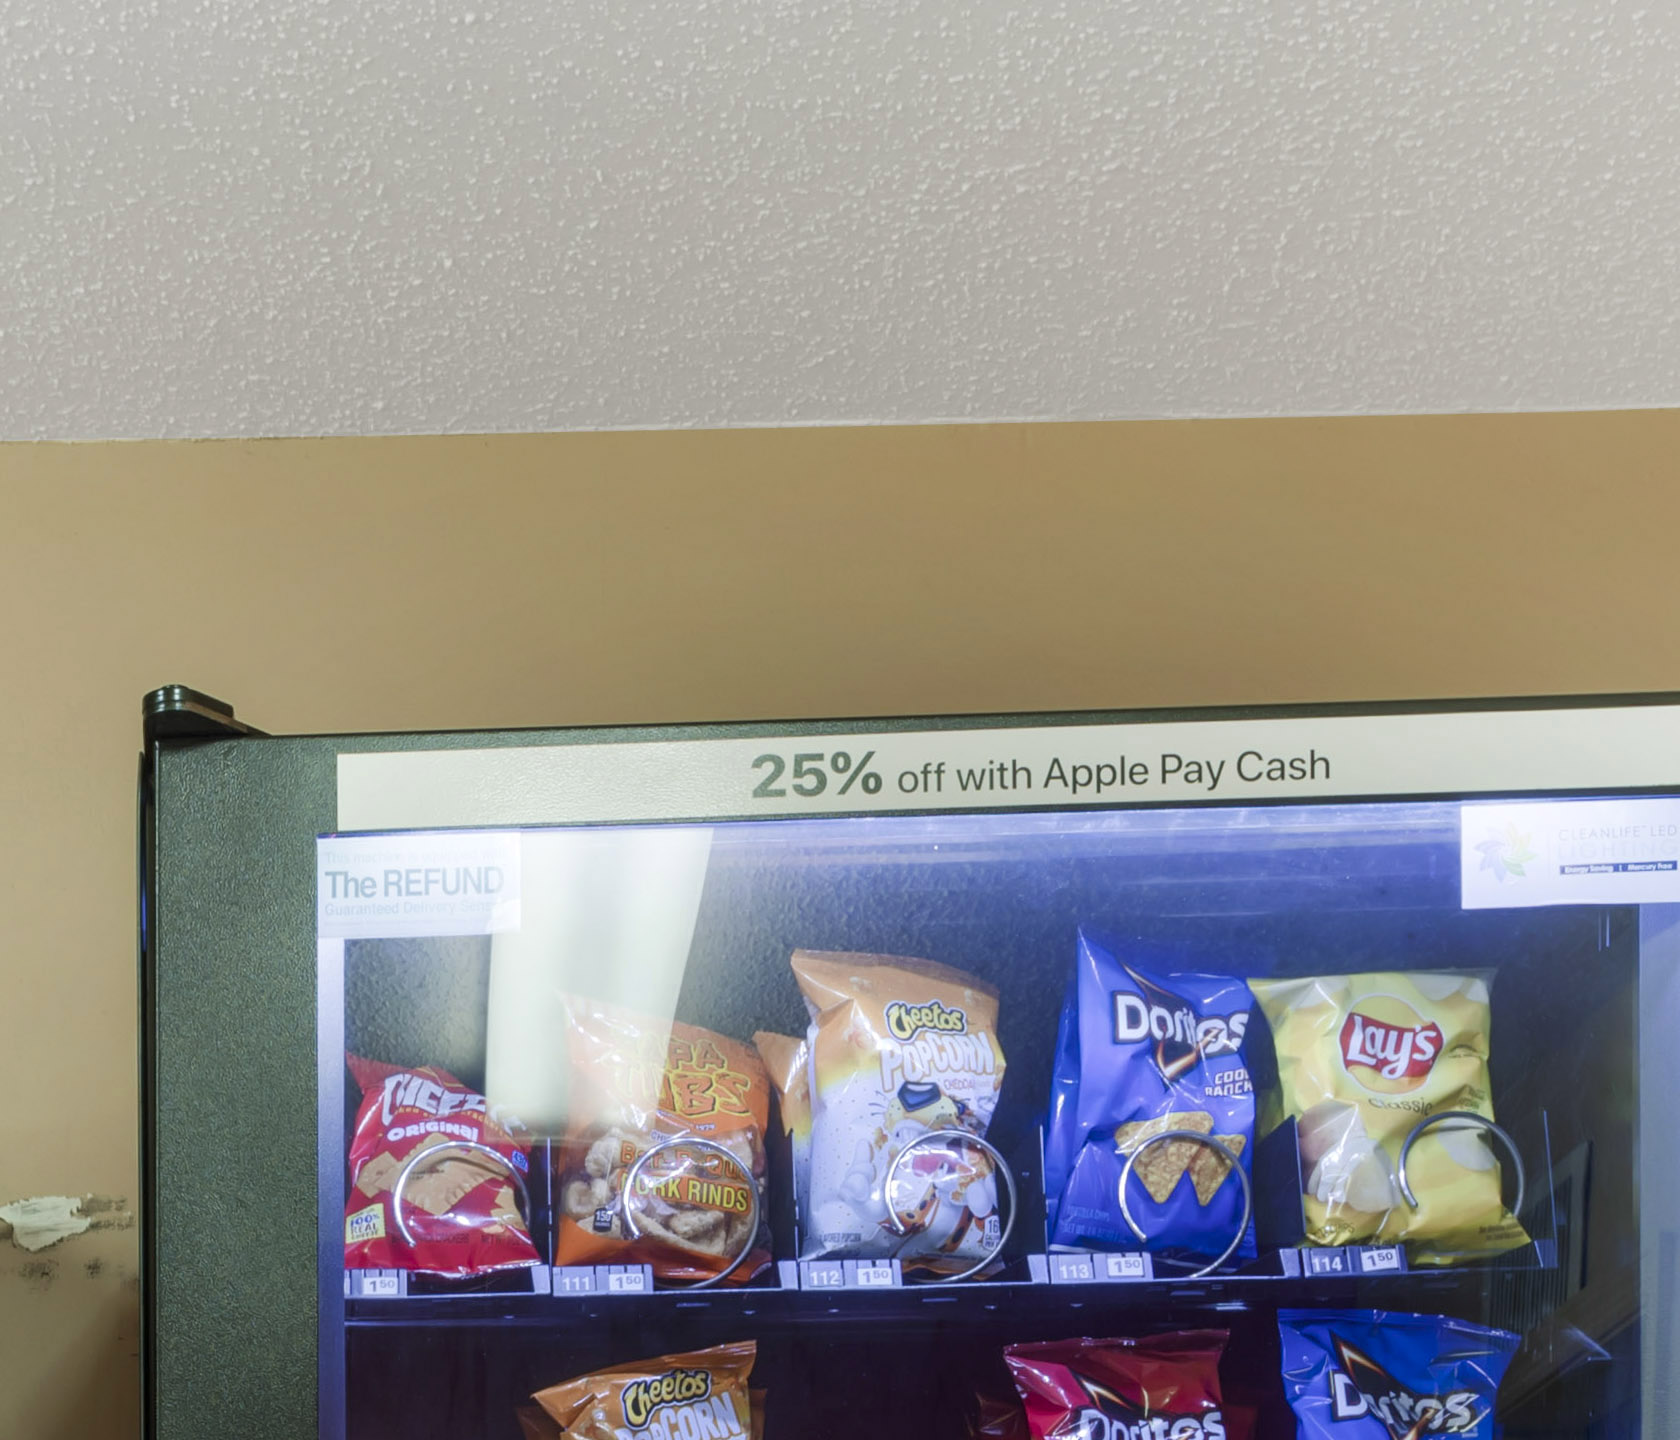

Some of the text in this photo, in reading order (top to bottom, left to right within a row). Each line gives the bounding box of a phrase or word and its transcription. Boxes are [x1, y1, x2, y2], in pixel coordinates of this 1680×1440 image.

[750, 750, 1330, 798] 25% off with Apple Pay Cash
[325, 867, 503, 898] The REFUND
[887, 1002, 965, 1042] Cheetos
[878, 1032, 995, 1092] POPCORN
[1348, 1011, 1438, 1076] Lay's
[562, 1275, 591, 1291] 111
[809, 1270, 839, 1286] 112
[1059, 1263, 1089, 1279] 113
[1312, 1256, 1342, 1271] 114
[624, 1370, 711, 1427] Cheetos
[1334, 1374, 1478, 1432] Doritos
